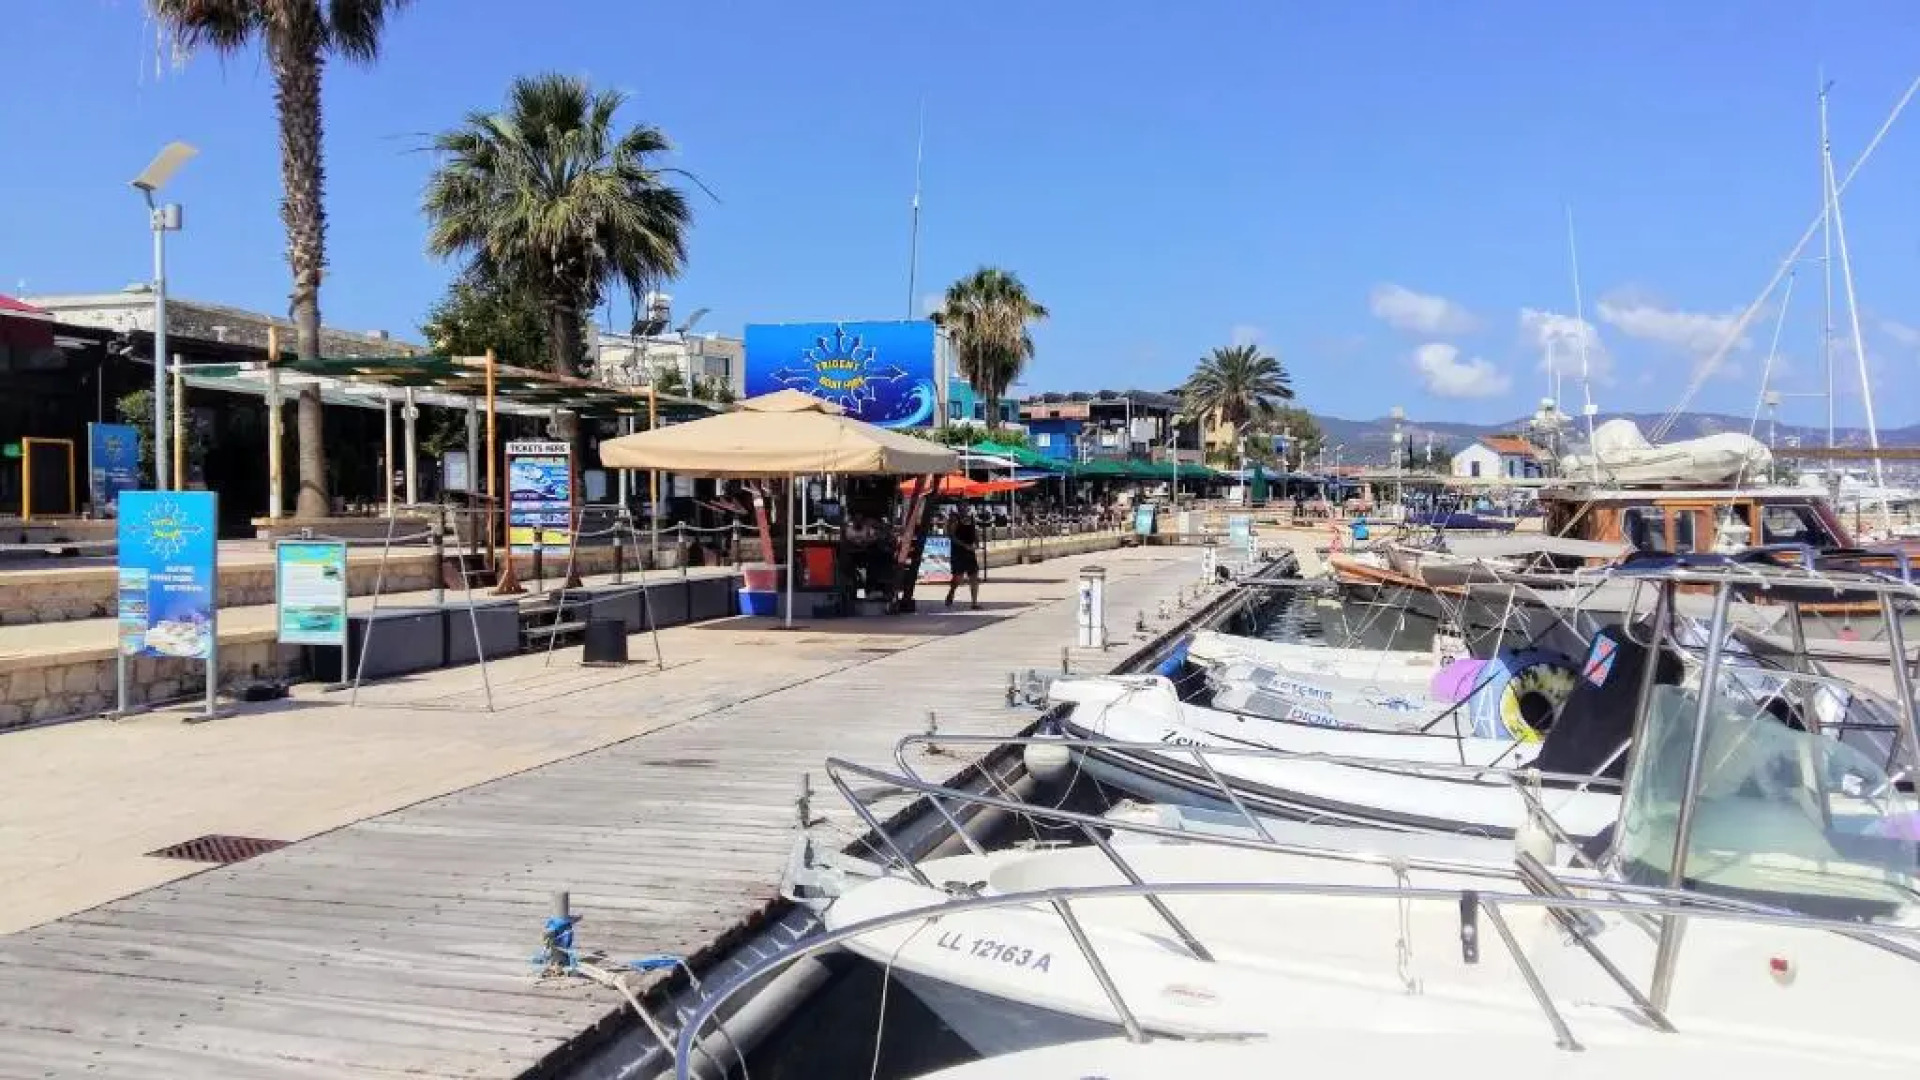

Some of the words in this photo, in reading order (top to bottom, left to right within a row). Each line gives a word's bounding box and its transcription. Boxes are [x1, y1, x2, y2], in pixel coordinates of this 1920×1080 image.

[815, 359, 861, 372] TRIDENT
[510, 443, 543, 453] TICKETS
[545, 443, 567, 453] HERE
[937, 931, 962, 951] LL
[970, 938, 1033, 967] 12163
[1031, 952, 1051, 974] A
